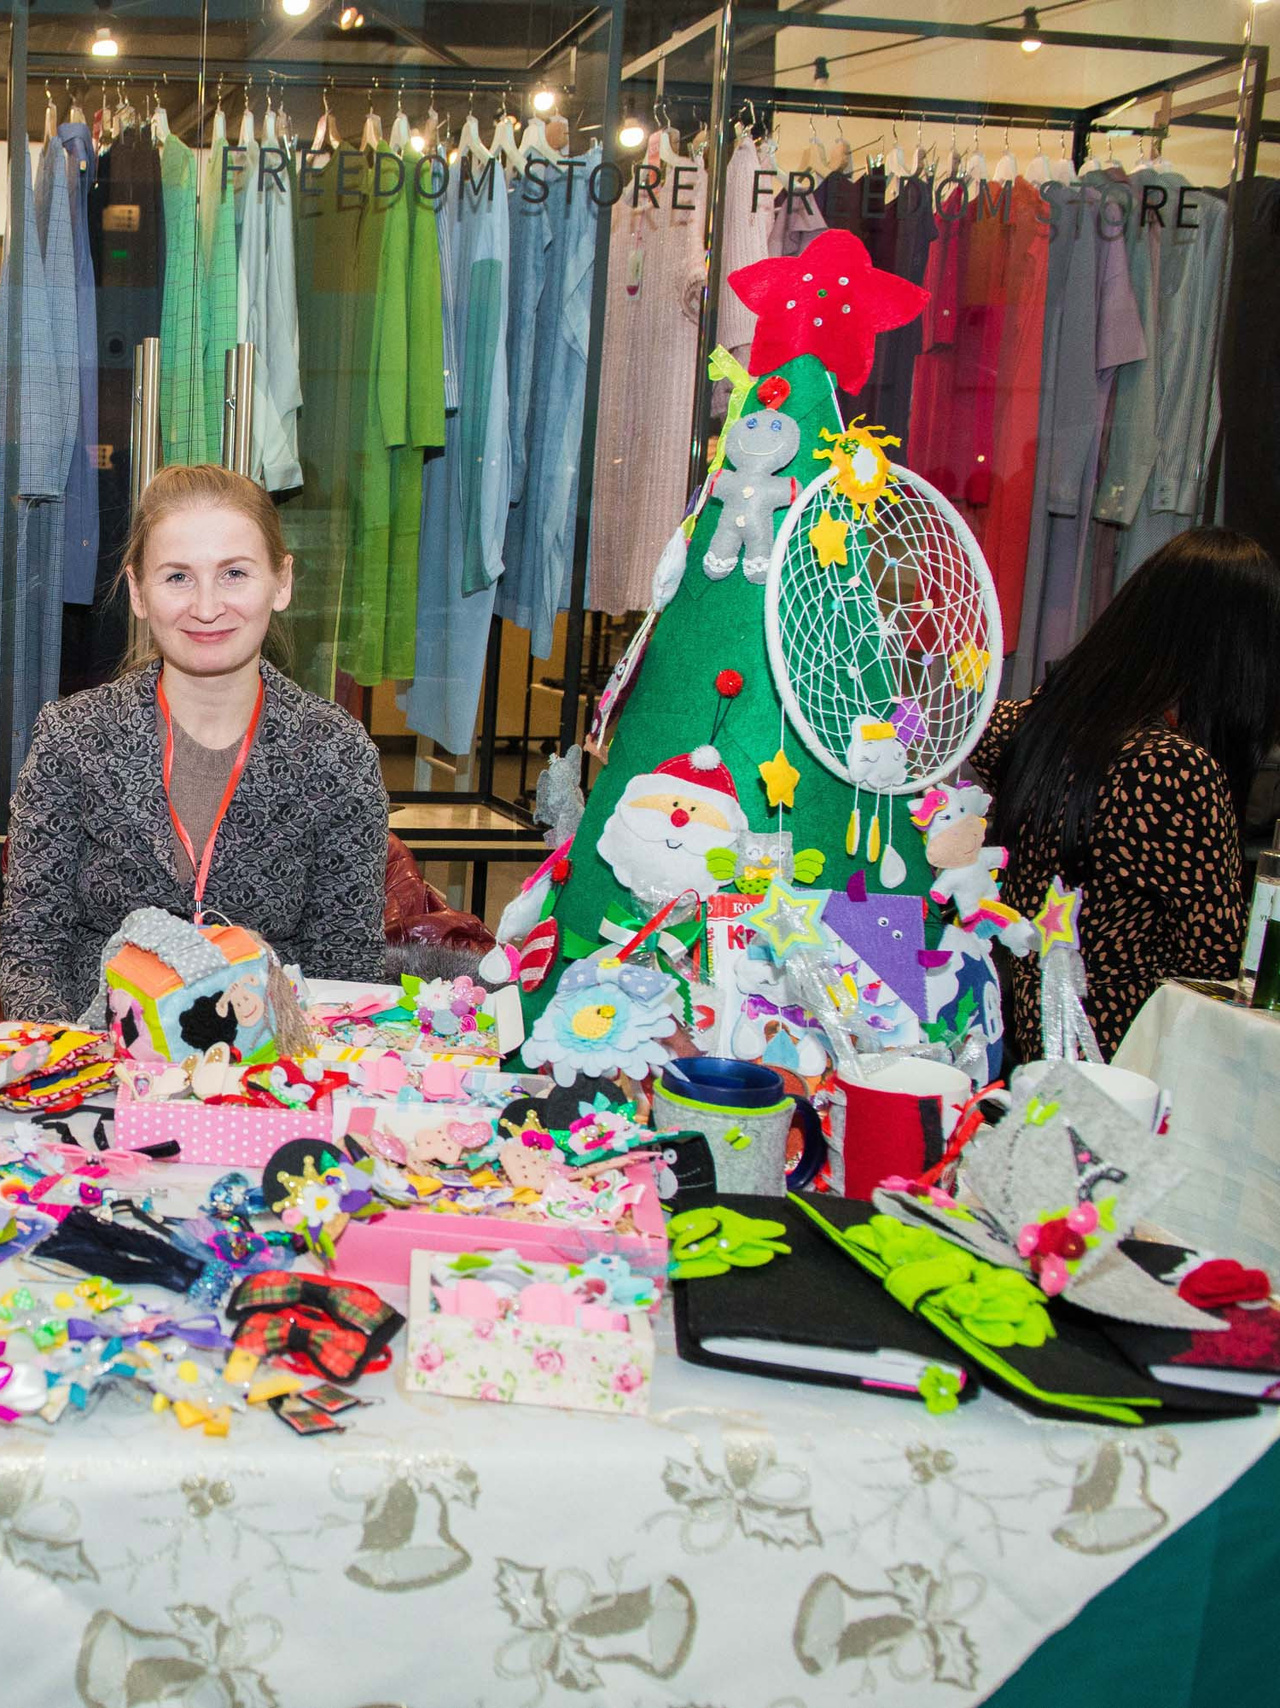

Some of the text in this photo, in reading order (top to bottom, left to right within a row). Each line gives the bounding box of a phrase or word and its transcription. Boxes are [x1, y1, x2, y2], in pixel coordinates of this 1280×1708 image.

[221, 146, 698, 210] FREEDOM STORE
[751, 169, 1204, 229] FREEDOM STORE
